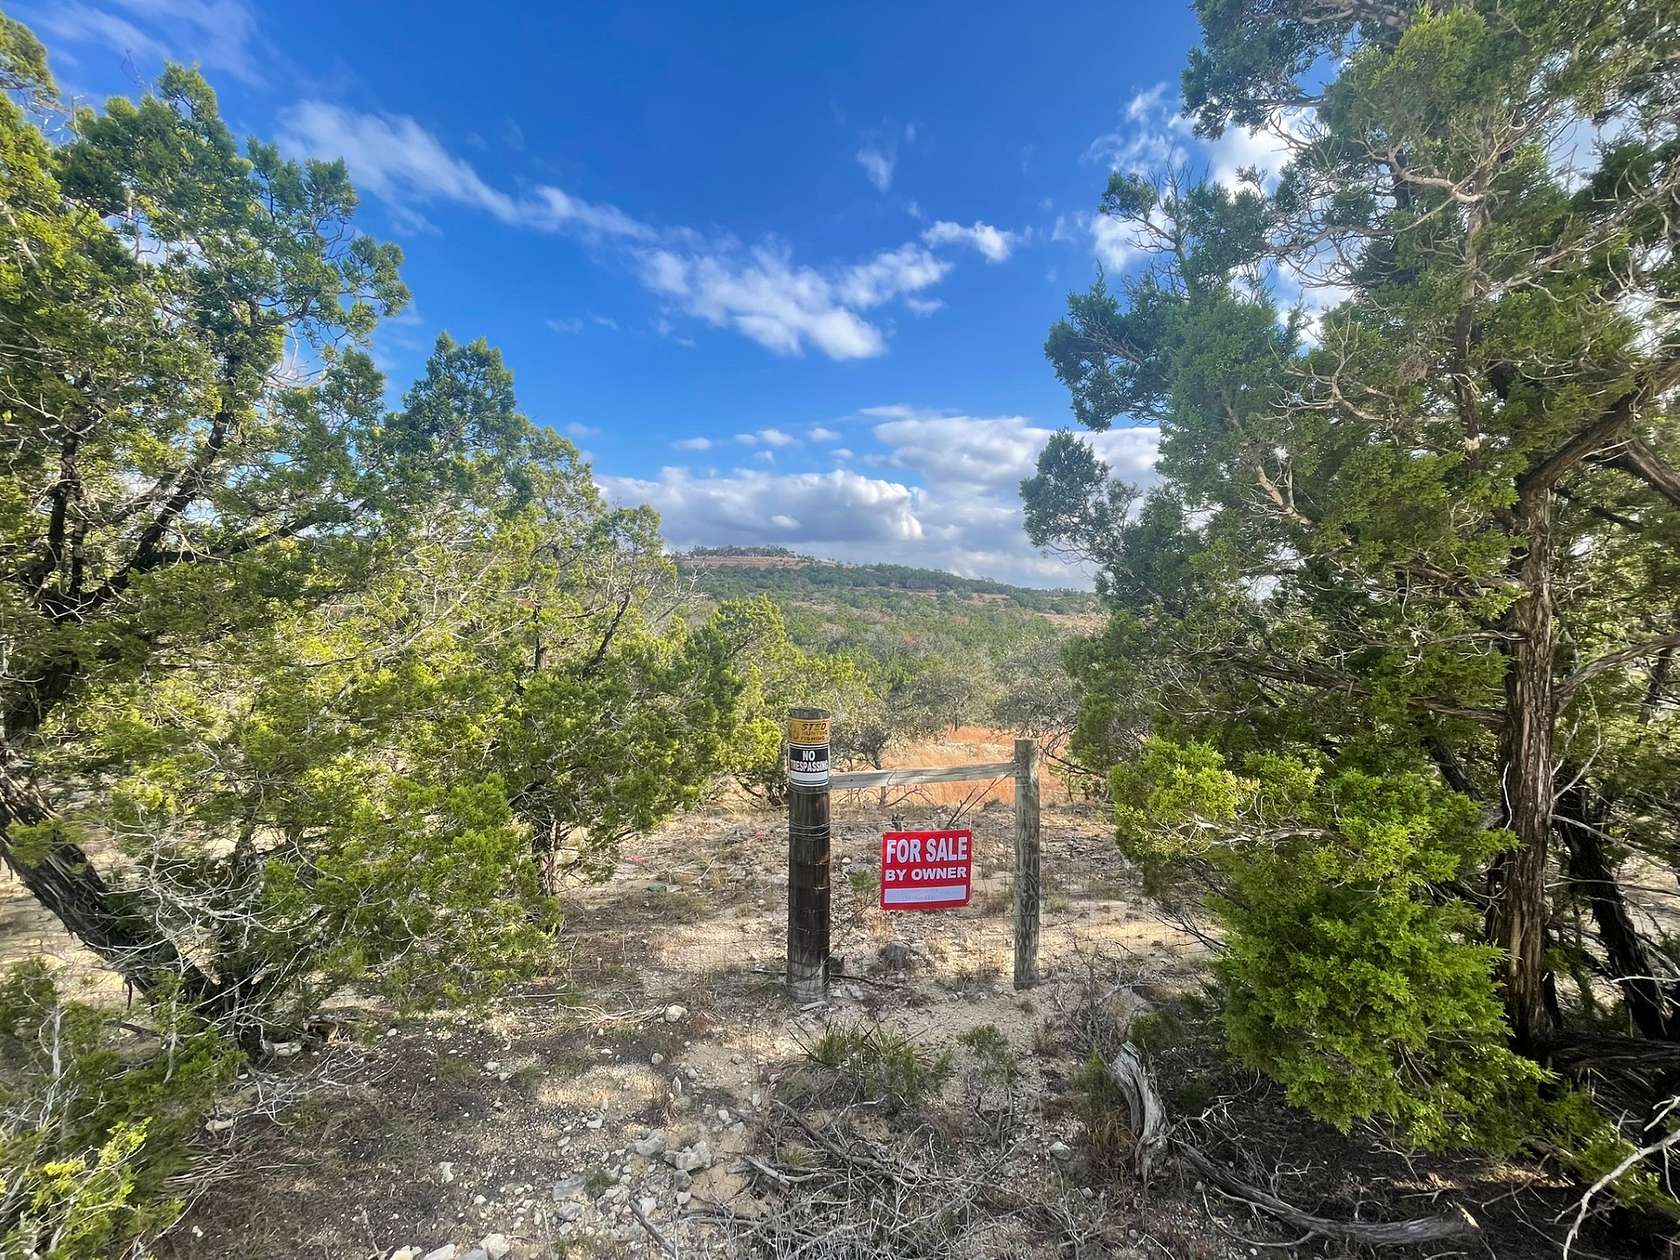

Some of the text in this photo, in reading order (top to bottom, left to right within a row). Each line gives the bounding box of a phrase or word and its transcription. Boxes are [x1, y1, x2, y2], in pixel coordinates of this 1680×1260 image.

[802, 750, 816, 761] NO
[886, 836, 968, 864] FOR SALE
[885, 866, 967, 882] BY OWNER
